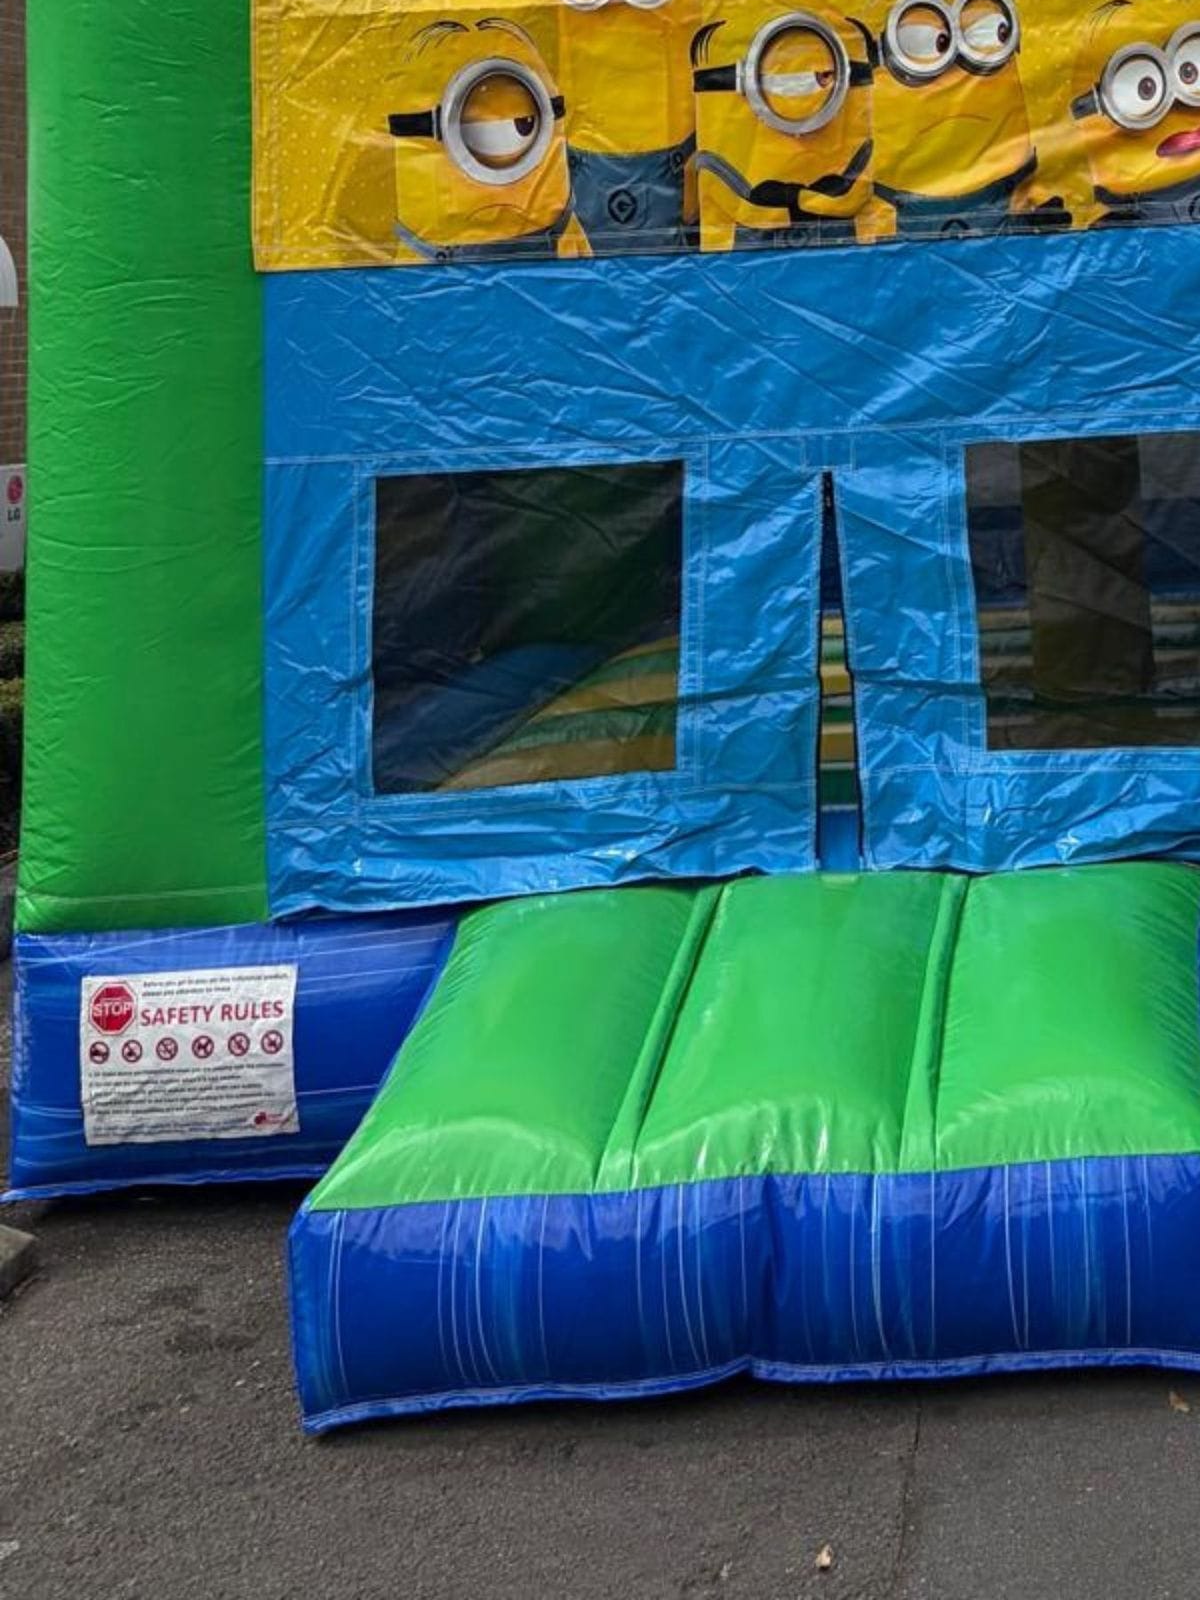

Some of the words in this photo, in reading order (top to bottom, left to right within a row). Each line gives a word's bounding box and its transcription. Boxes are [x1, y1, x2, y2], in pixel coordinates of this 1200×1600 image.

[92, 1001, 131, 1017] STOP
[140, 1005, 214, 1026] SAFETY
[221, 1001, 284, 1021] RULES
